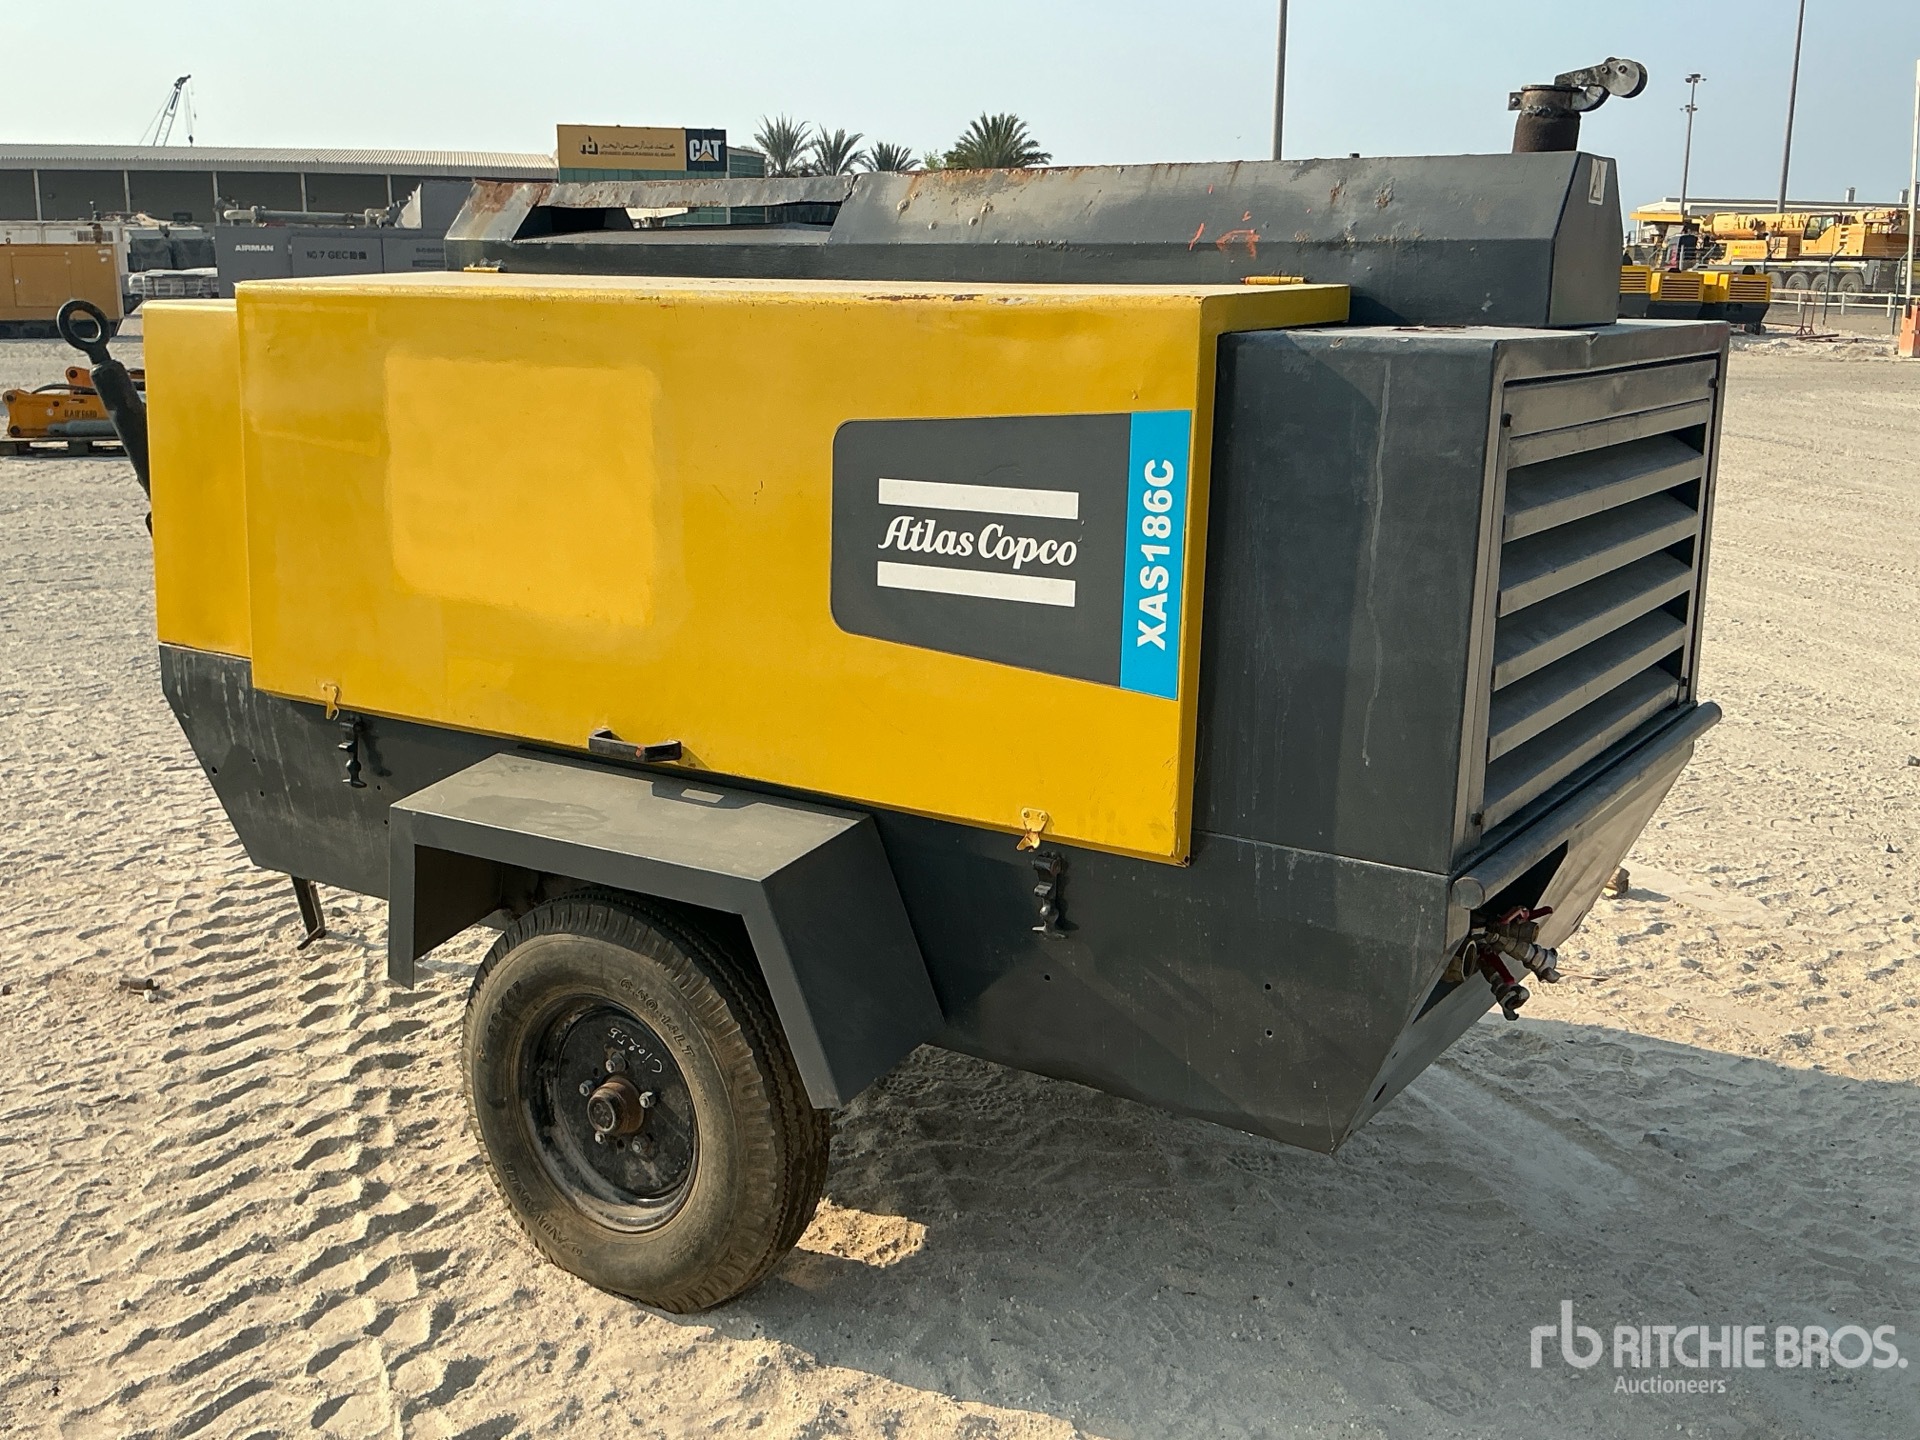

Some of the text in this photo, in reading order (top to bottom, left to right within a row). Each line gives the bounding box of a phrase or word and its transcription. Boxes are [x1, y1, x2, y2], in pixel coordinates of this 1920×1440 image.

[689, 139, 720, 161] CAT
[235, 244, 274, 252] AIRMAN
[878, 515, 1077, 569] Atlas Copco
[1137, 459, 1174, 651] XAS186C
